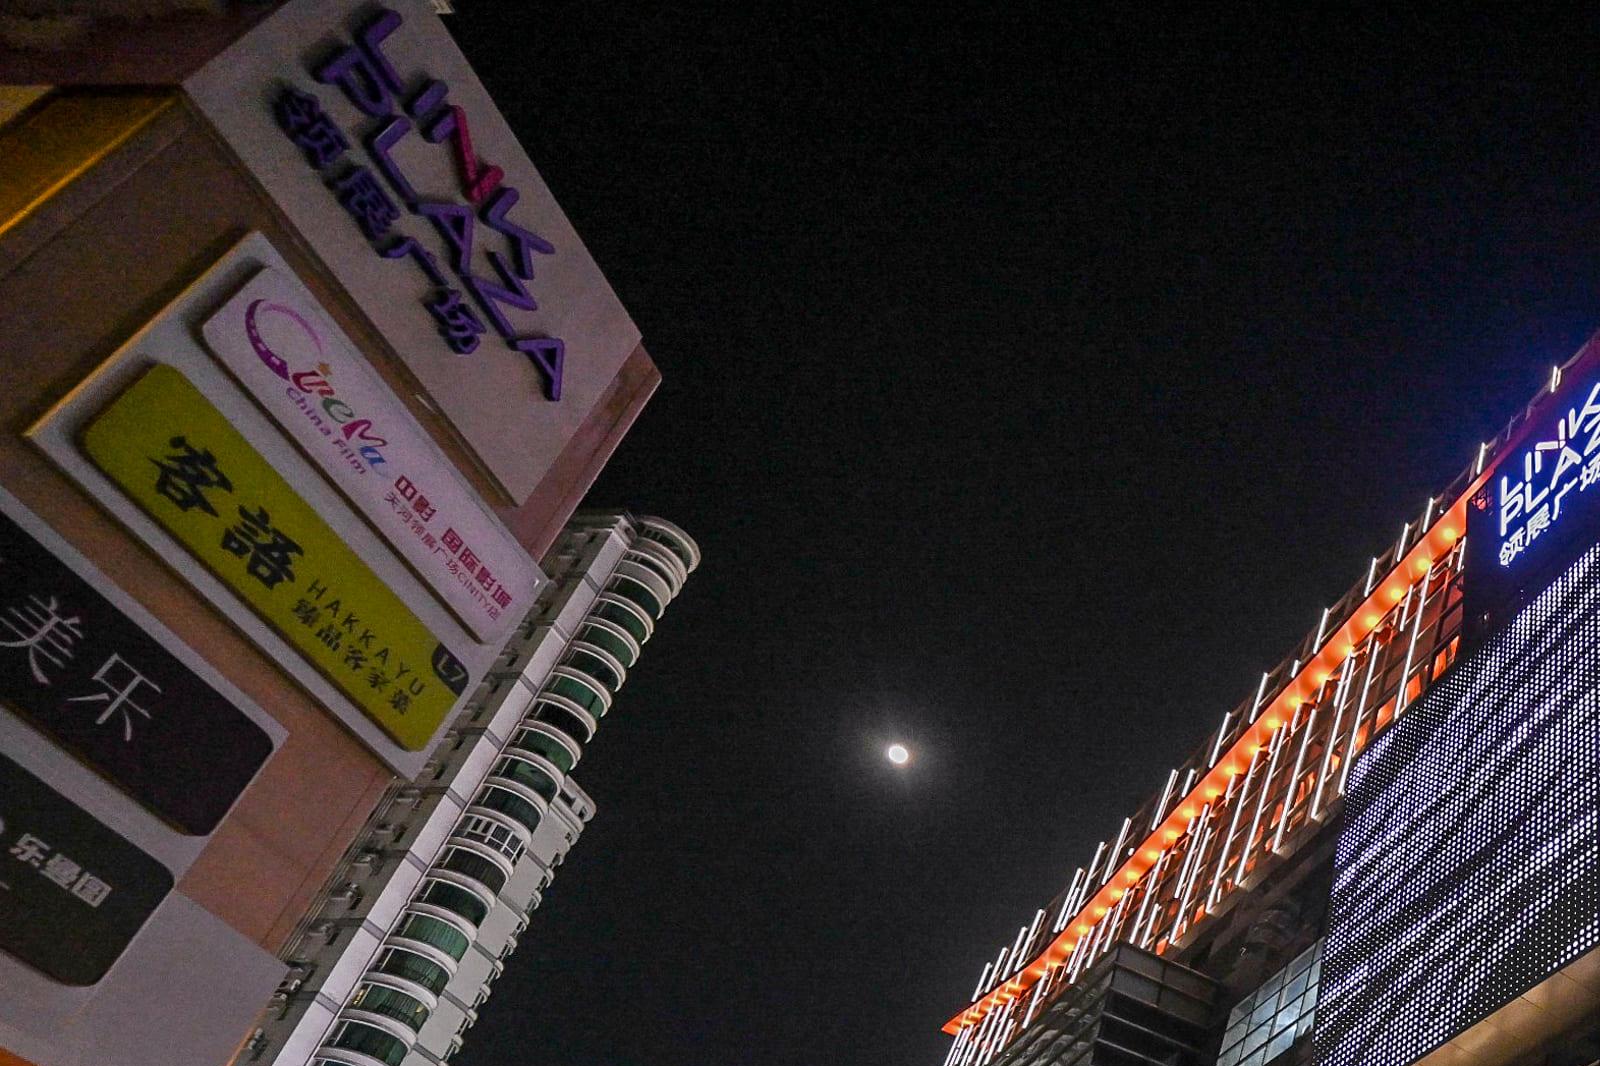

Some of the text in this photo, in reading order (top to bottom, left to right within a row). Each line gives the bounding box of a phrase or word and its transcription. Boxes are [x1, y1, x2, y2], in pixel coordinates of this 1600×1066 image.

[364, 9, 555, 281] LINK
[277, 86, 487, 355] 领展广场
[316, 43, 565, 402] PLAZA
[148, 435, 303, 592] 客語
[333, 438, 367, 475] Film
[395, 475, 513, 609] 中影 国际影城
[307, 579, 426, 697] HAKKAYU
[437, 653, 467, 683] L7
